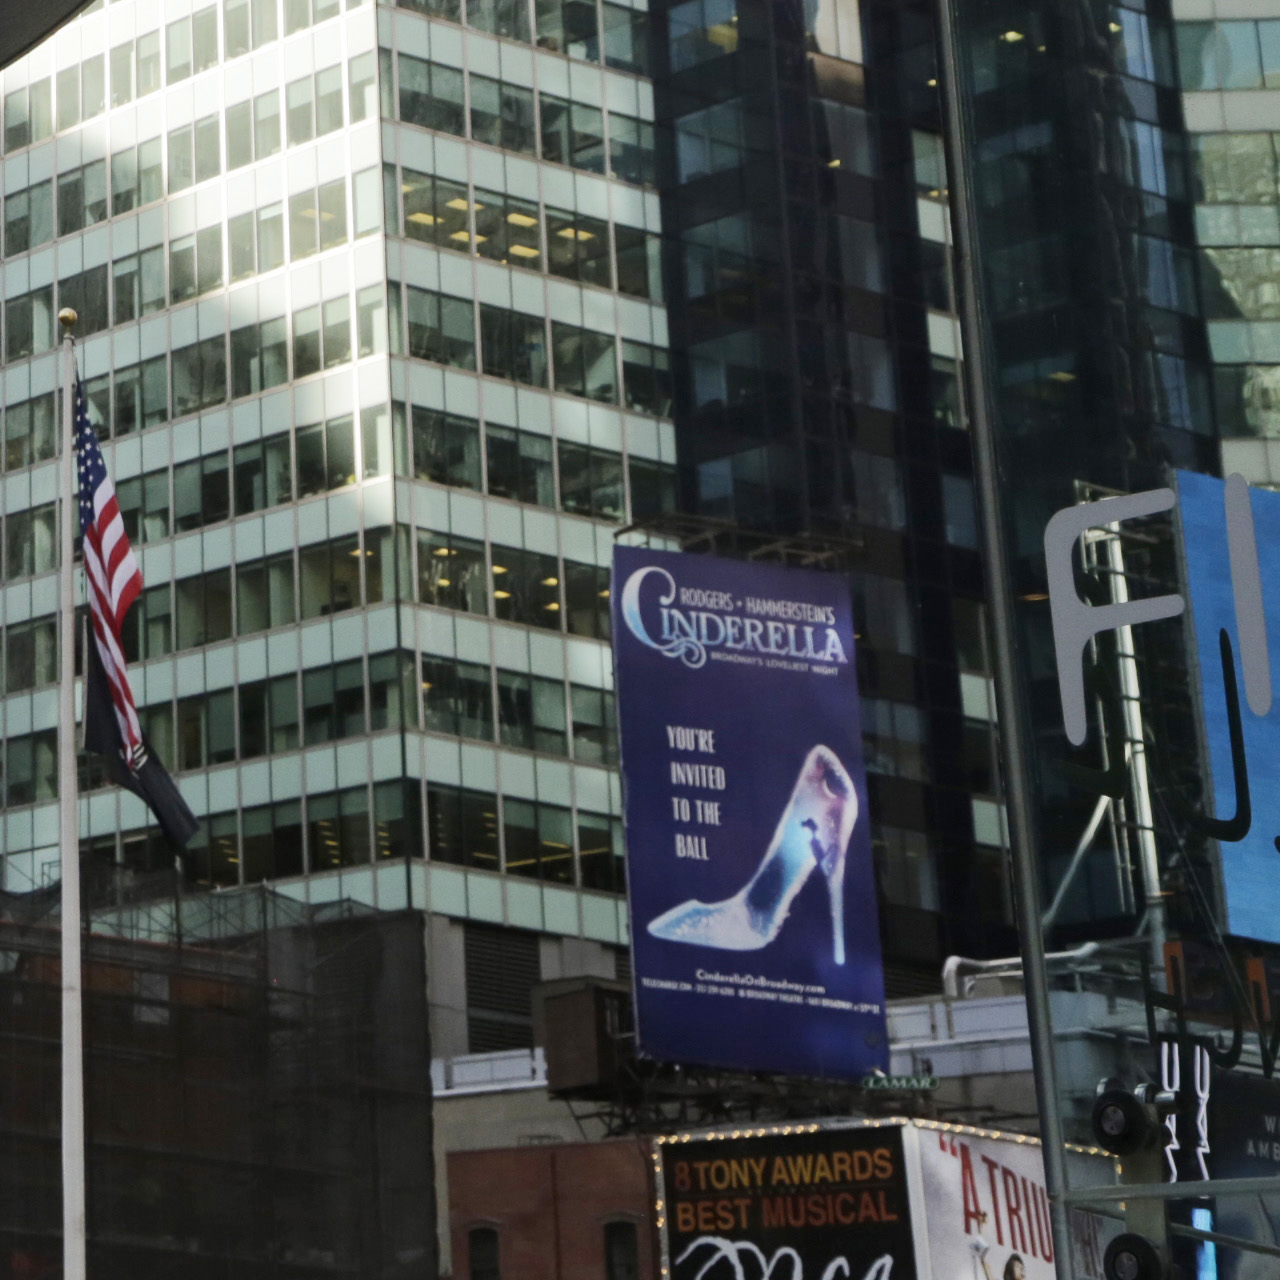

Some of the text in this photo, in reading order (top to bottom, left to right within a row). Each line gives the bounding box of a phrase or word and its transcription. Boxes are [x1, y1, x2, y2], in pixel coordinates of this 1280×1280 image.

[680, 587, 734, 611] RODGERS
[621, 565, 849, 669] CINDERELLA
[671, 762, 725, 790] INVITED
[672, 797, 721, 826] TO THE
[675, 833, 710, 861] BALL
[696, 968, 826, 994] CinderellaOnBroadway.com
[868, 1077, 933, 1090] LAMAR
[675, 1161, 691, 1191] 8
[695, 1156, 767, 1190] TONY
[771, 1149, 894, 1186] AWARDS
[675, 1190, 898, 1233] BEST MUSICAL
[981, 1155, 1053, 1263] TRIU
